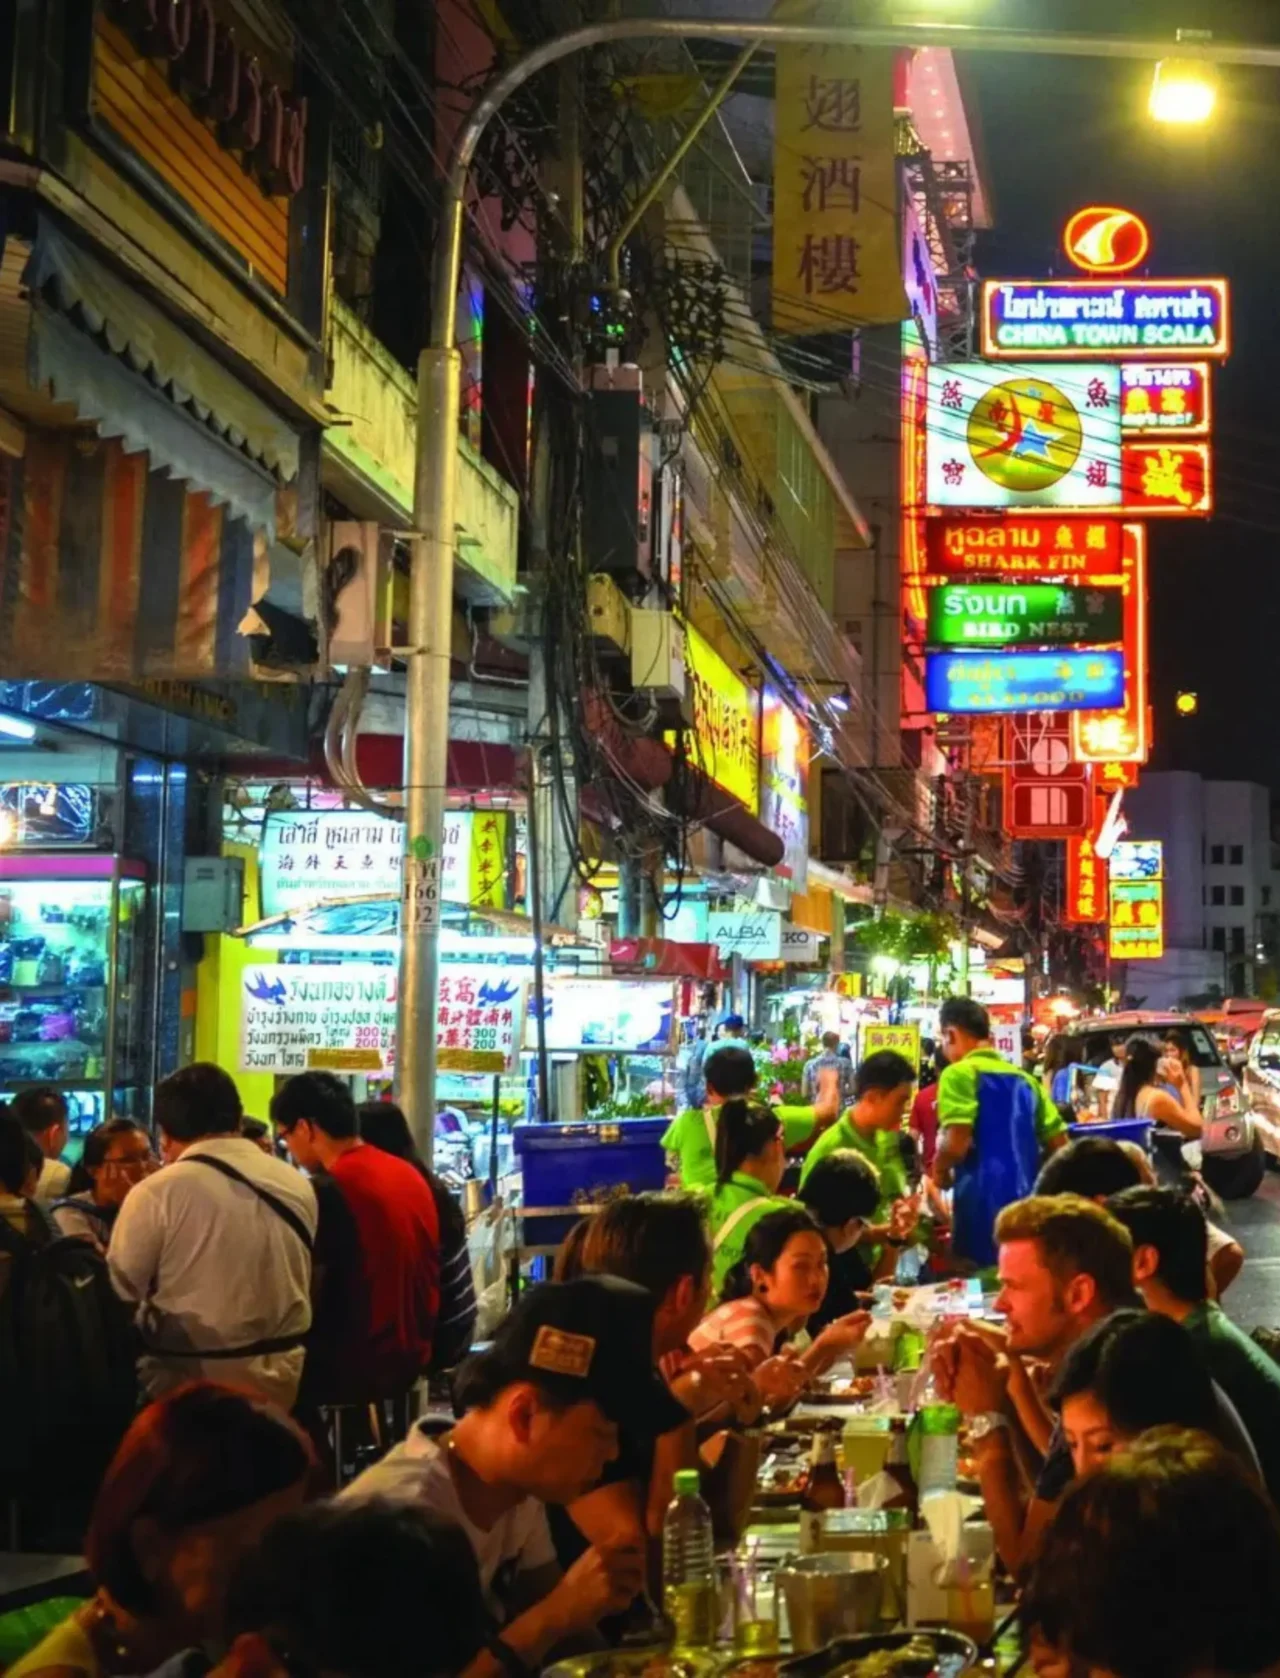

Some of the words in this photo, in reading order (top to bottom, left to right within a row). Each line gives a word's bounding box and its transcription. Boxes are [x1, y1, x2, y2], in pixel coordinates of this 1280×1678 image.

[997, 323, 1068, 347] CHINA
[1071, 323, 1138, 346] TOWN
[1142, 323, 1216, 346] SCALA
[944, 526, 1041, 556] หูฉลาม
[963, 553, 1042, 570] SHARK
[1048, 553, 1088, 570] FIN
[943, 587, 1028, 616] รังนก
[962, 621, 1020, 638] BIRD
[1028, 621, 1090, 637] NEST
[715, 925, 767, 940] ALBA
[355, 1026, 380, 1038] 300
[473, 1027, 497, 1039] 300
[355, 1037, 380, 1049] 200
[473, 1038, 497, 1050] 200
